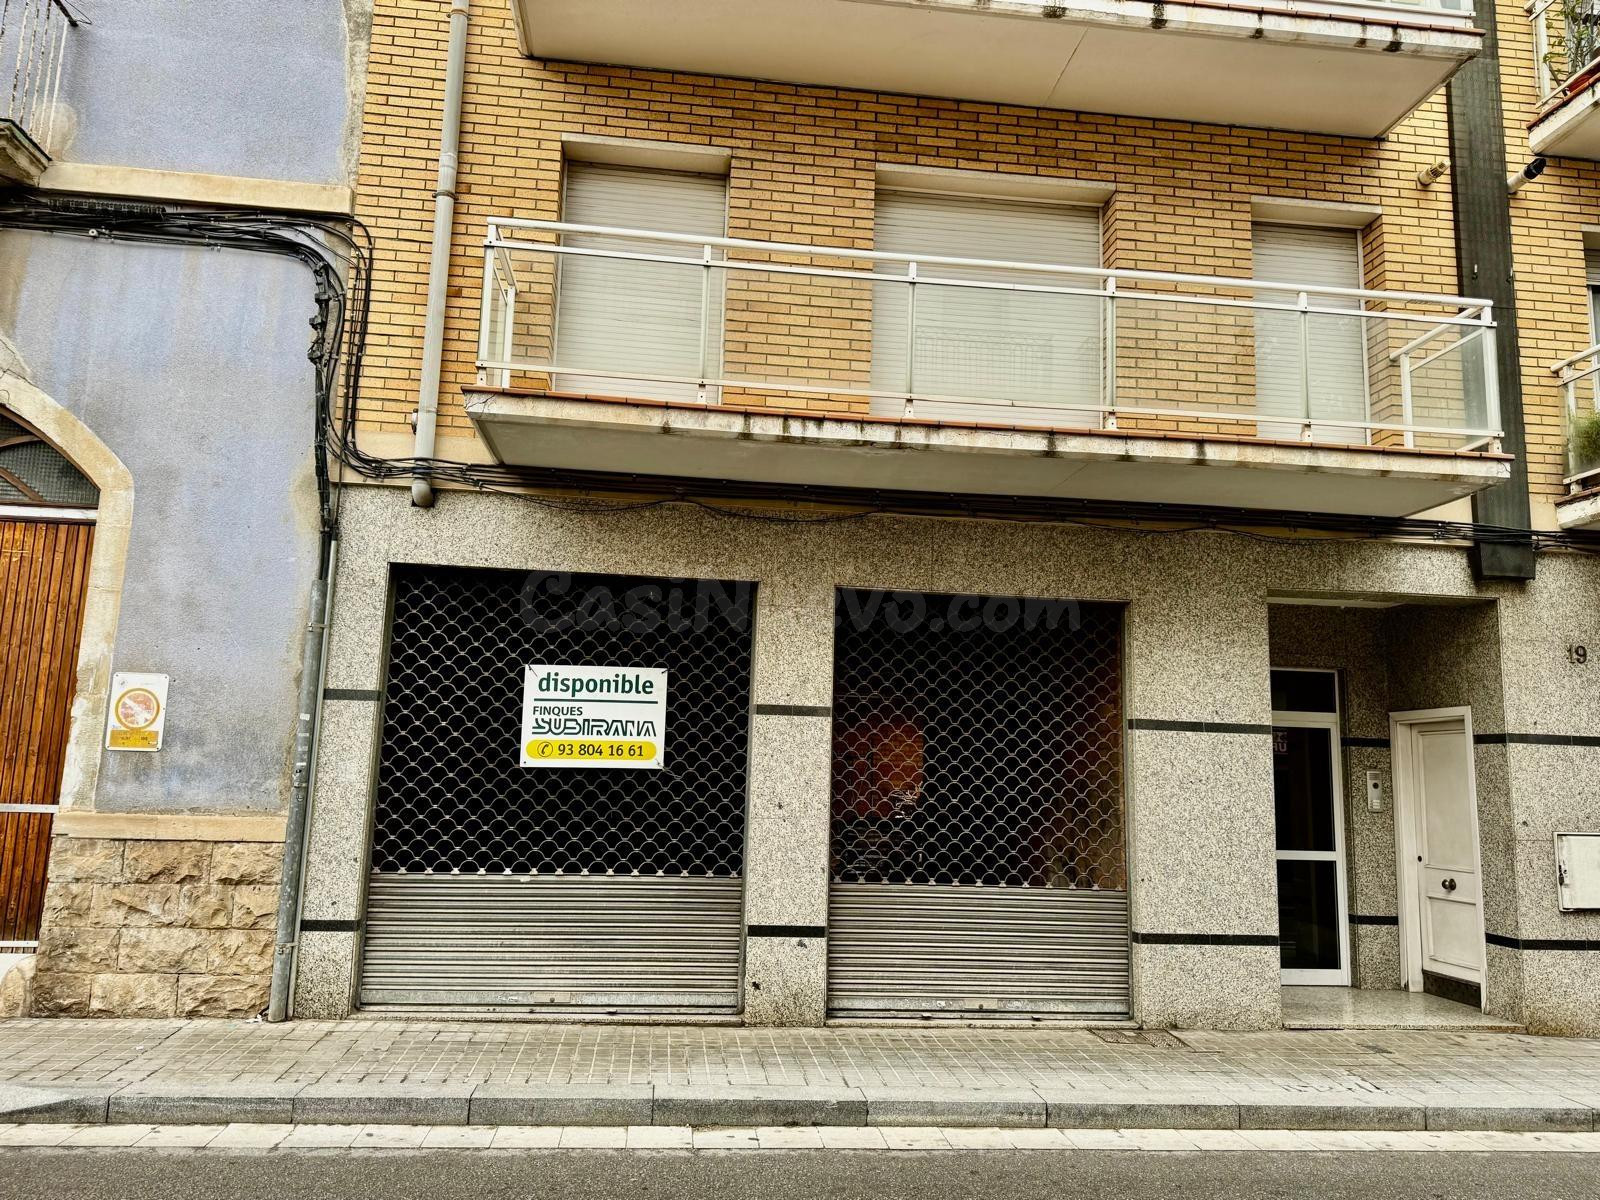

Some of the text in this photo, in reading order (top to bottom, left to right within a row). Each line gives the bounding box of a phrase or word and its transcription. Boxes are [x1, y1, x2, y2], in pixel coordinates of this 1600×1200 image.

[1566, 644, 1587, 664] 19
[538, 672, 654, 697] disponible
[533, 706, 583, 716] FINQUES
[531, 718, 657, 737] SUBIRANA
[558, 744, 644, 757] 93 804 16 61
